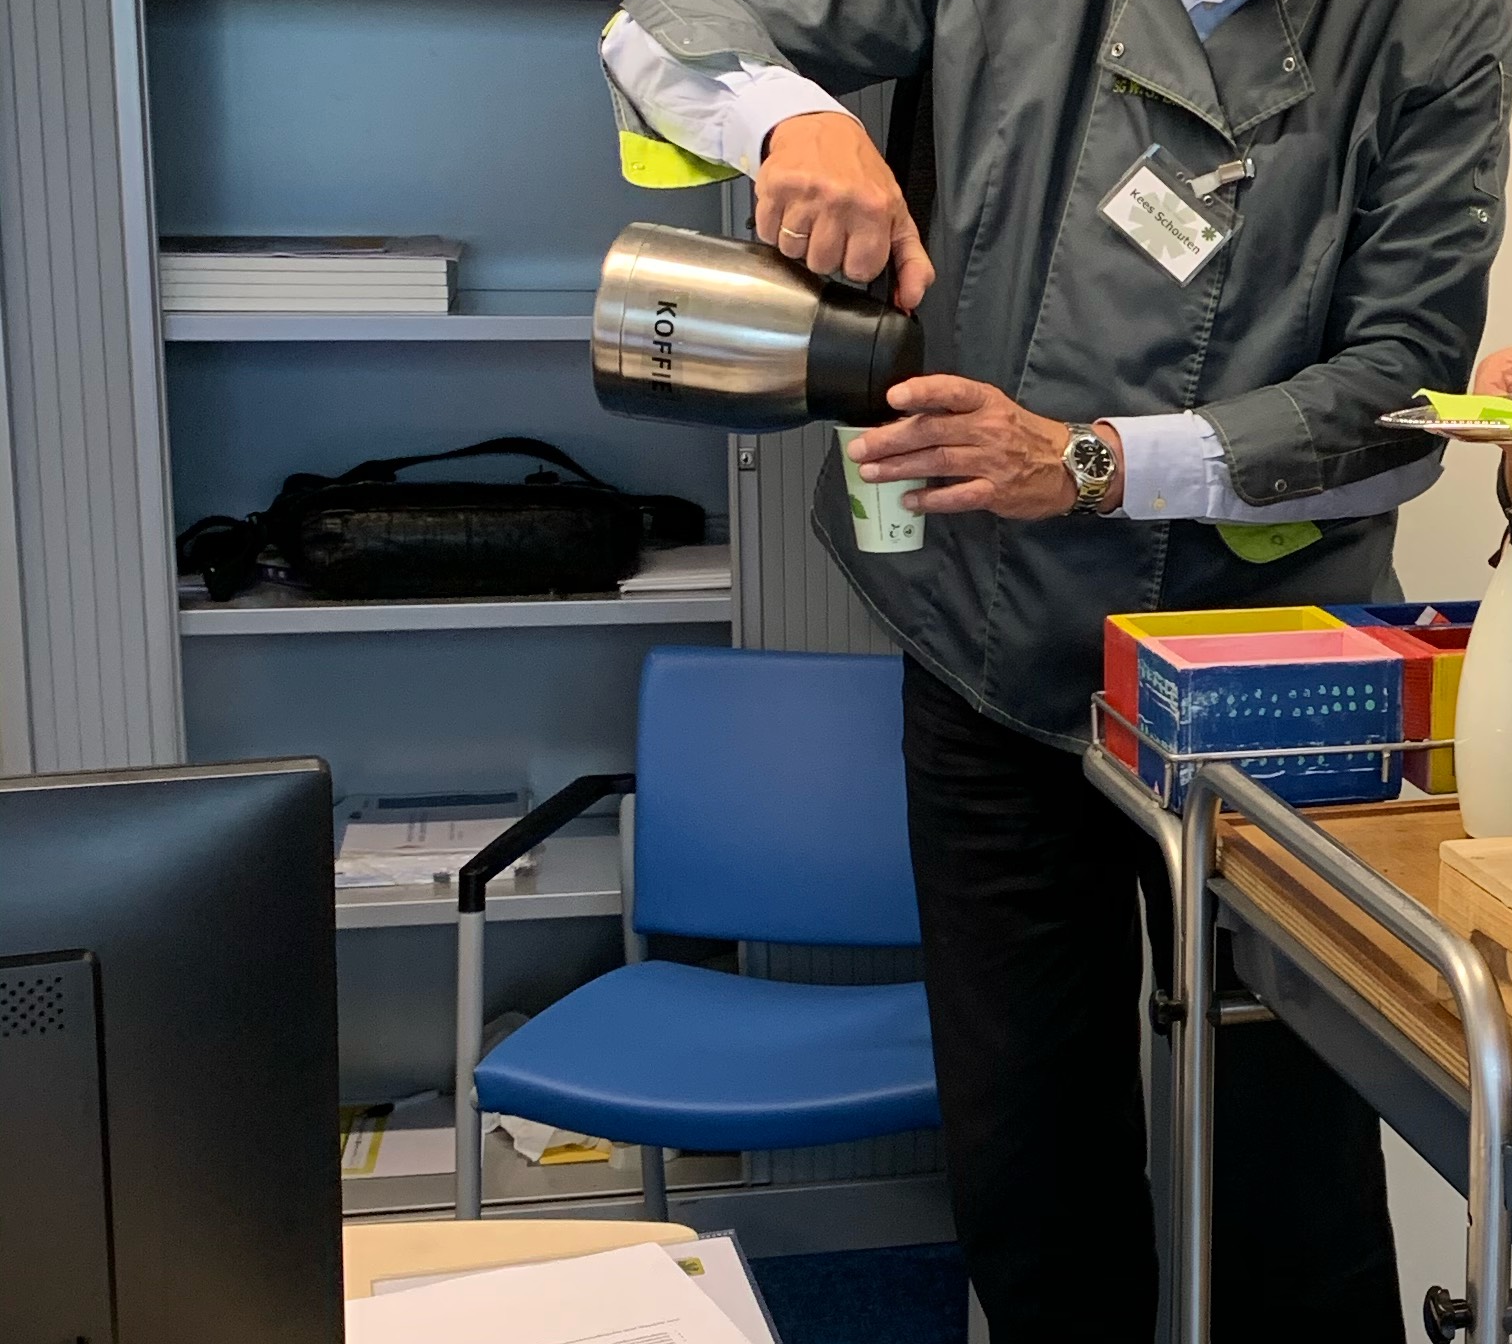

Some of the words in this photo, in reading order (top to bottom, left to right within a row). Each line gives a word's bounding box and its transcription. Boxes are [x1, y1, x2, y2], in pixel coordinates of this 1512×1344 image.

[1129, 188, 1154, 215] Kees
[1154, 211, 1201, 255] Schouten
[651, 300, 678, 394] KOFFIE
